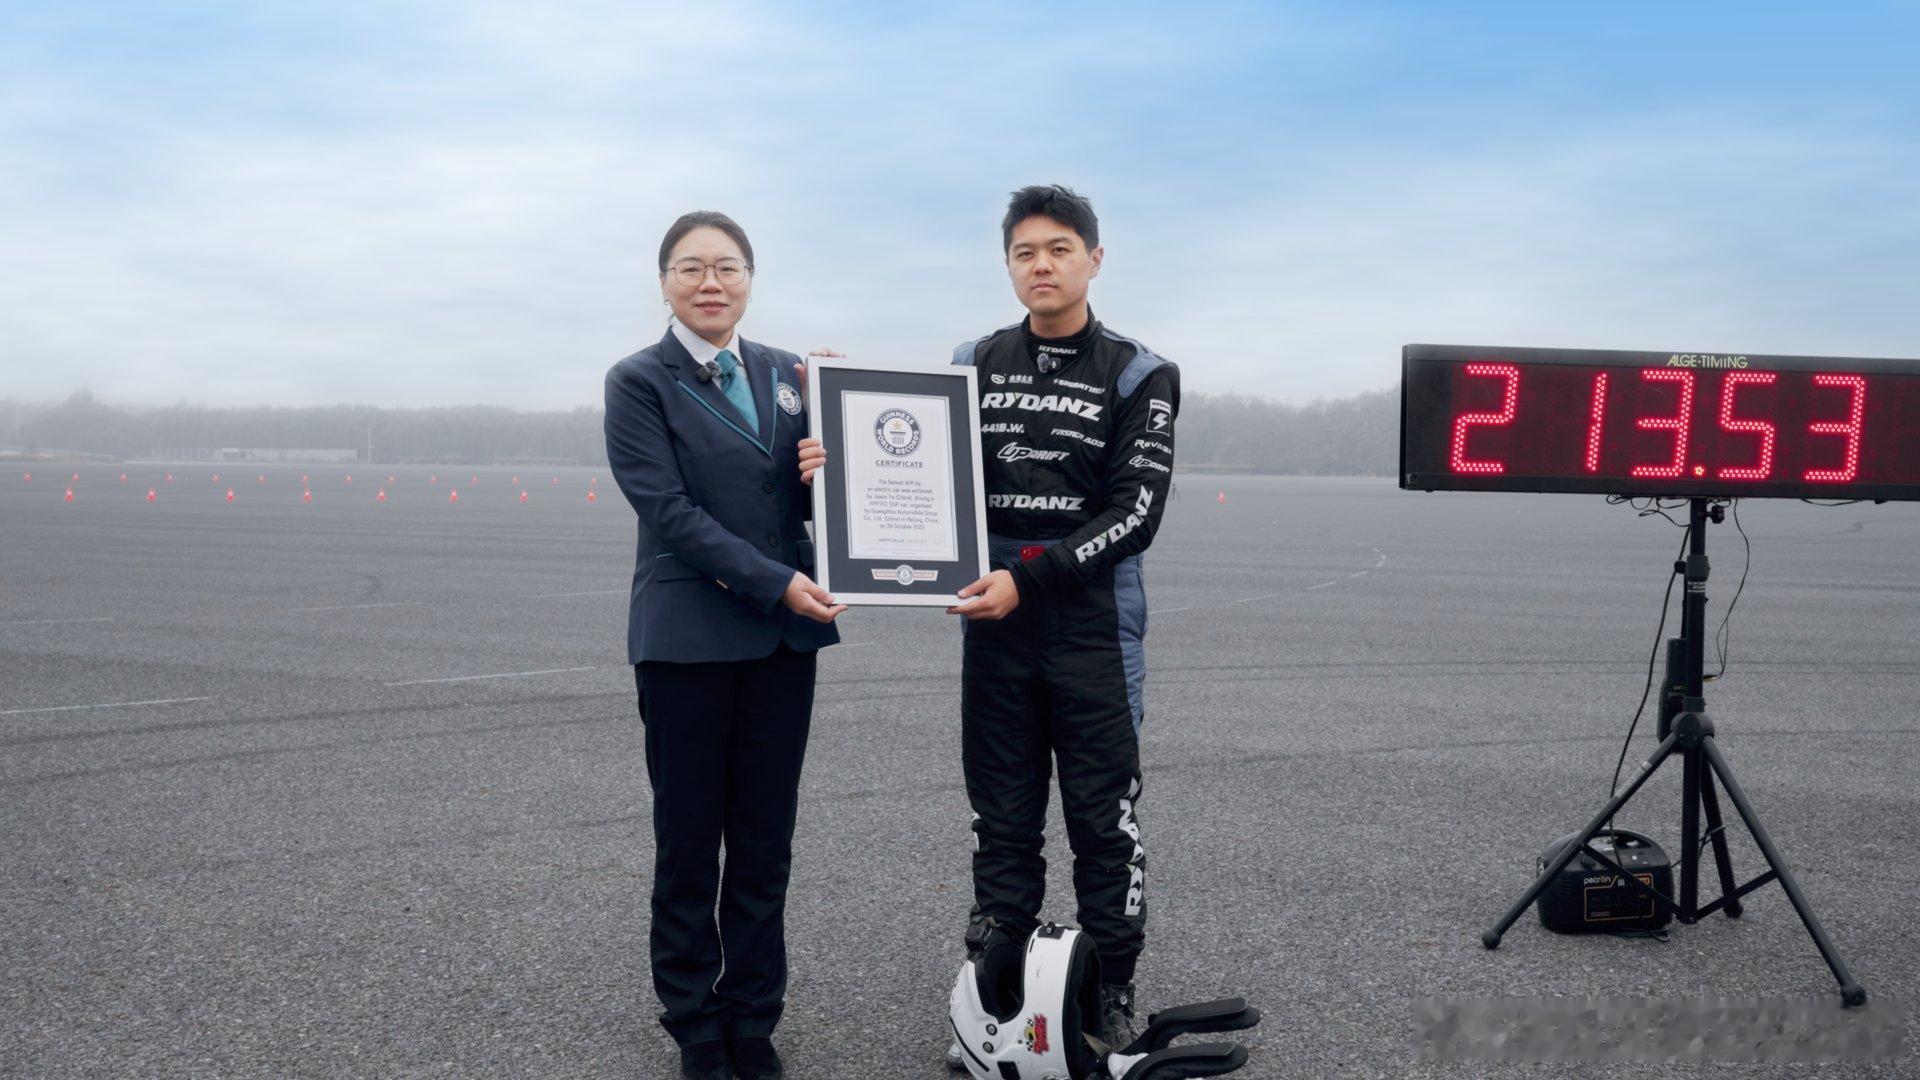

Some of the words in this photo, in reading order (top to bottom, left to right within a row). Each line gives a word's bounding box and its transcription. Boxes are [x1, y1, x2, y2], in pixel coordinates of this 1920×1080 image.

[1038, 345, 1078, 355] RYDANZ
[1667, 354, 1748, 368] ALGE-TIMING
[981, 392, 1103, 422] RYDANZ
[880, 410, 915, 426] GUINNESS
[876, 428, 894, 453] WORLD
[895, 430, 920, 455] RECORDS
[875, 460, 923, 469] CERTIFICATE
[988, 494, 1085, 511] RYDANZ
[1075, 484, 1154, 564] RYDANZ
